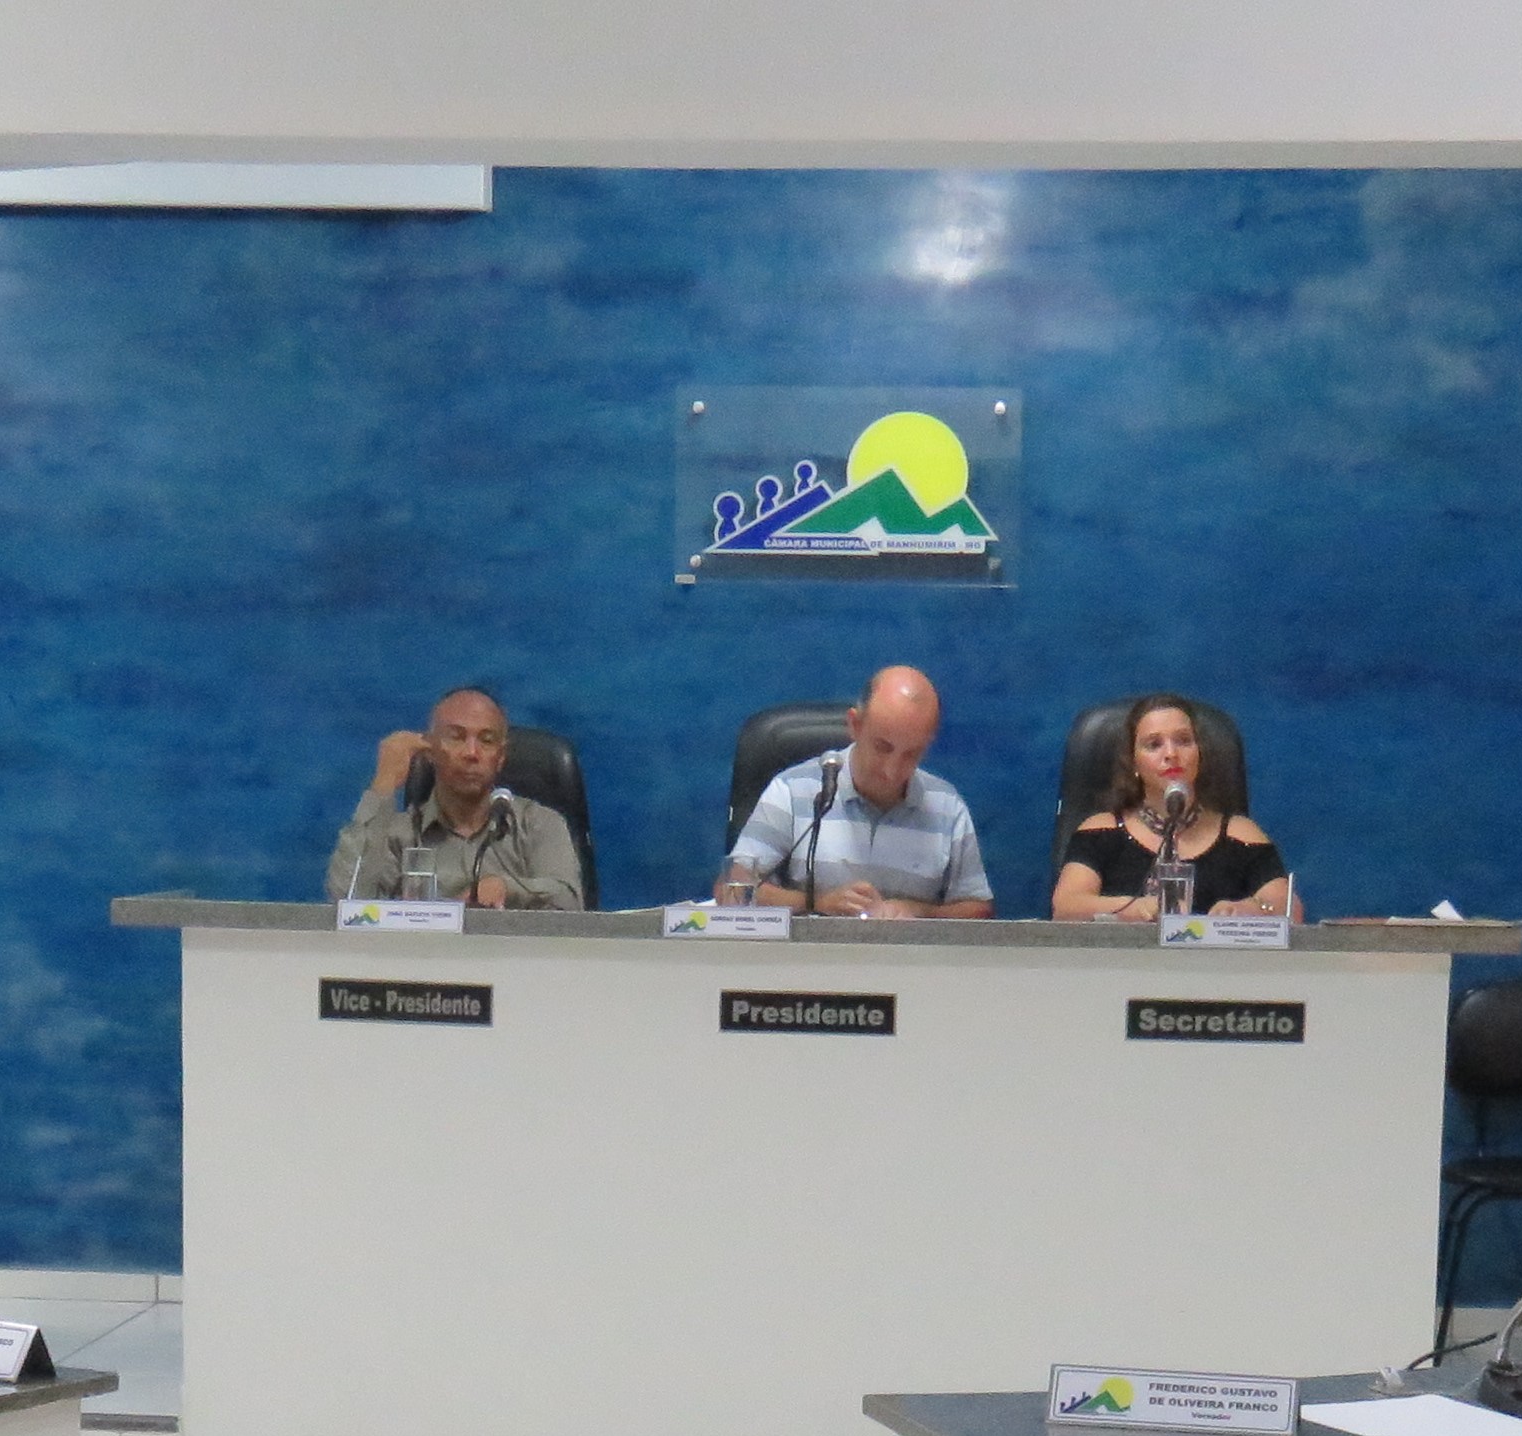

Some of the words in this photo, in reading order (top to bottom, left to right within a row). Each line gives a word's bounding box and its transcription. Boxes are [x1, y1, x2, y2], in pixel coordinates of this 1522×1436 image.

[330, 988, 370, 1012] Vice
[385, 990, 482, 1016] Presidente
[732, 999, 885, 1026] Presidente
[1138, 1008, 1294, 1034] Secretário
[1148, 1382, 1217, 1395] FREDERICO
[1221, 1387, 1278, 1398] GUSTAVO
[1148, 1397, 1164, 1405] DE
[1168, 1397, 1226, 1410] OLIVEIRA
[1228, 1401, 1278, 1413] FRANCO
